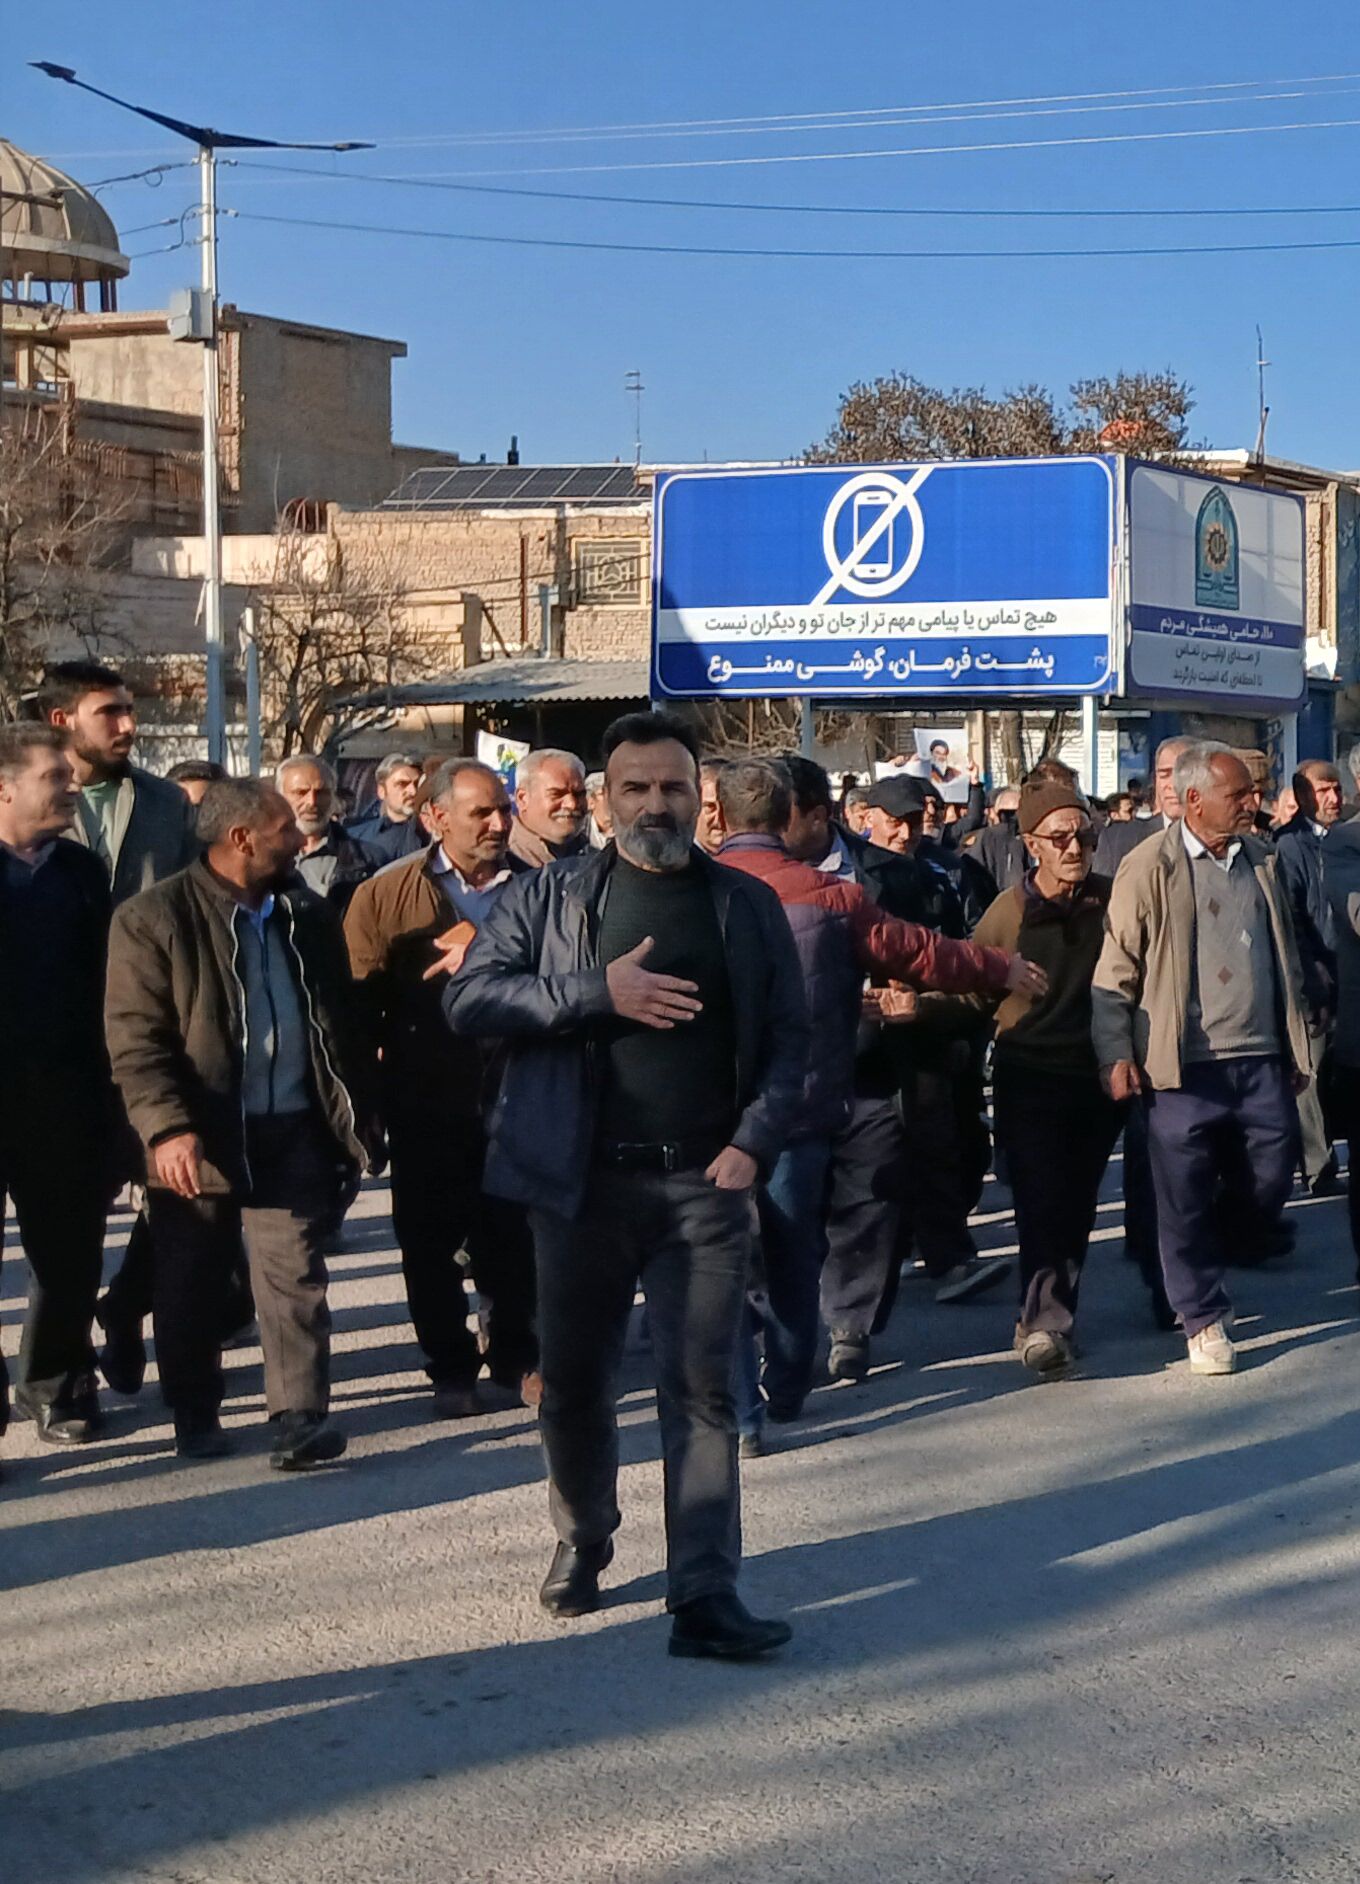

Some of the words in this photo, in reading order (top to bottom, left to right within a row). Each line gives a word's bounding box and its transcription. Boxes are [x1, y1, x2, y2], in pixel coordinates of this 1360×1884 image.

[704, 616, 748, 635] نیست
[750, 612, 796, 636] دیگران
[798, 620, 807, 634] و
[809, 614, 825, 634] تو
[827, 614, 855, 634] جان
[859, 610, 871, 635] از
[870, 613, 886, 635] تر
[887, 615, 915, 634] مهم
[918, 610, 959, 632] پیامی
[962, 608, 975, 631] یا
[977, 608, 1021, 631] تماس
[1023, 609, 1057, 631] هیچ
[1159, 616, 1185, 635] مردم
[1186, 614, 1229, 638] همیشگی
[1230, 621, 1259, 641] حامی
[706, 653, 794, 683] ممنوع
[796, 645, 886, 680] گوشی
[974, 645, 1055, 678] پشت
